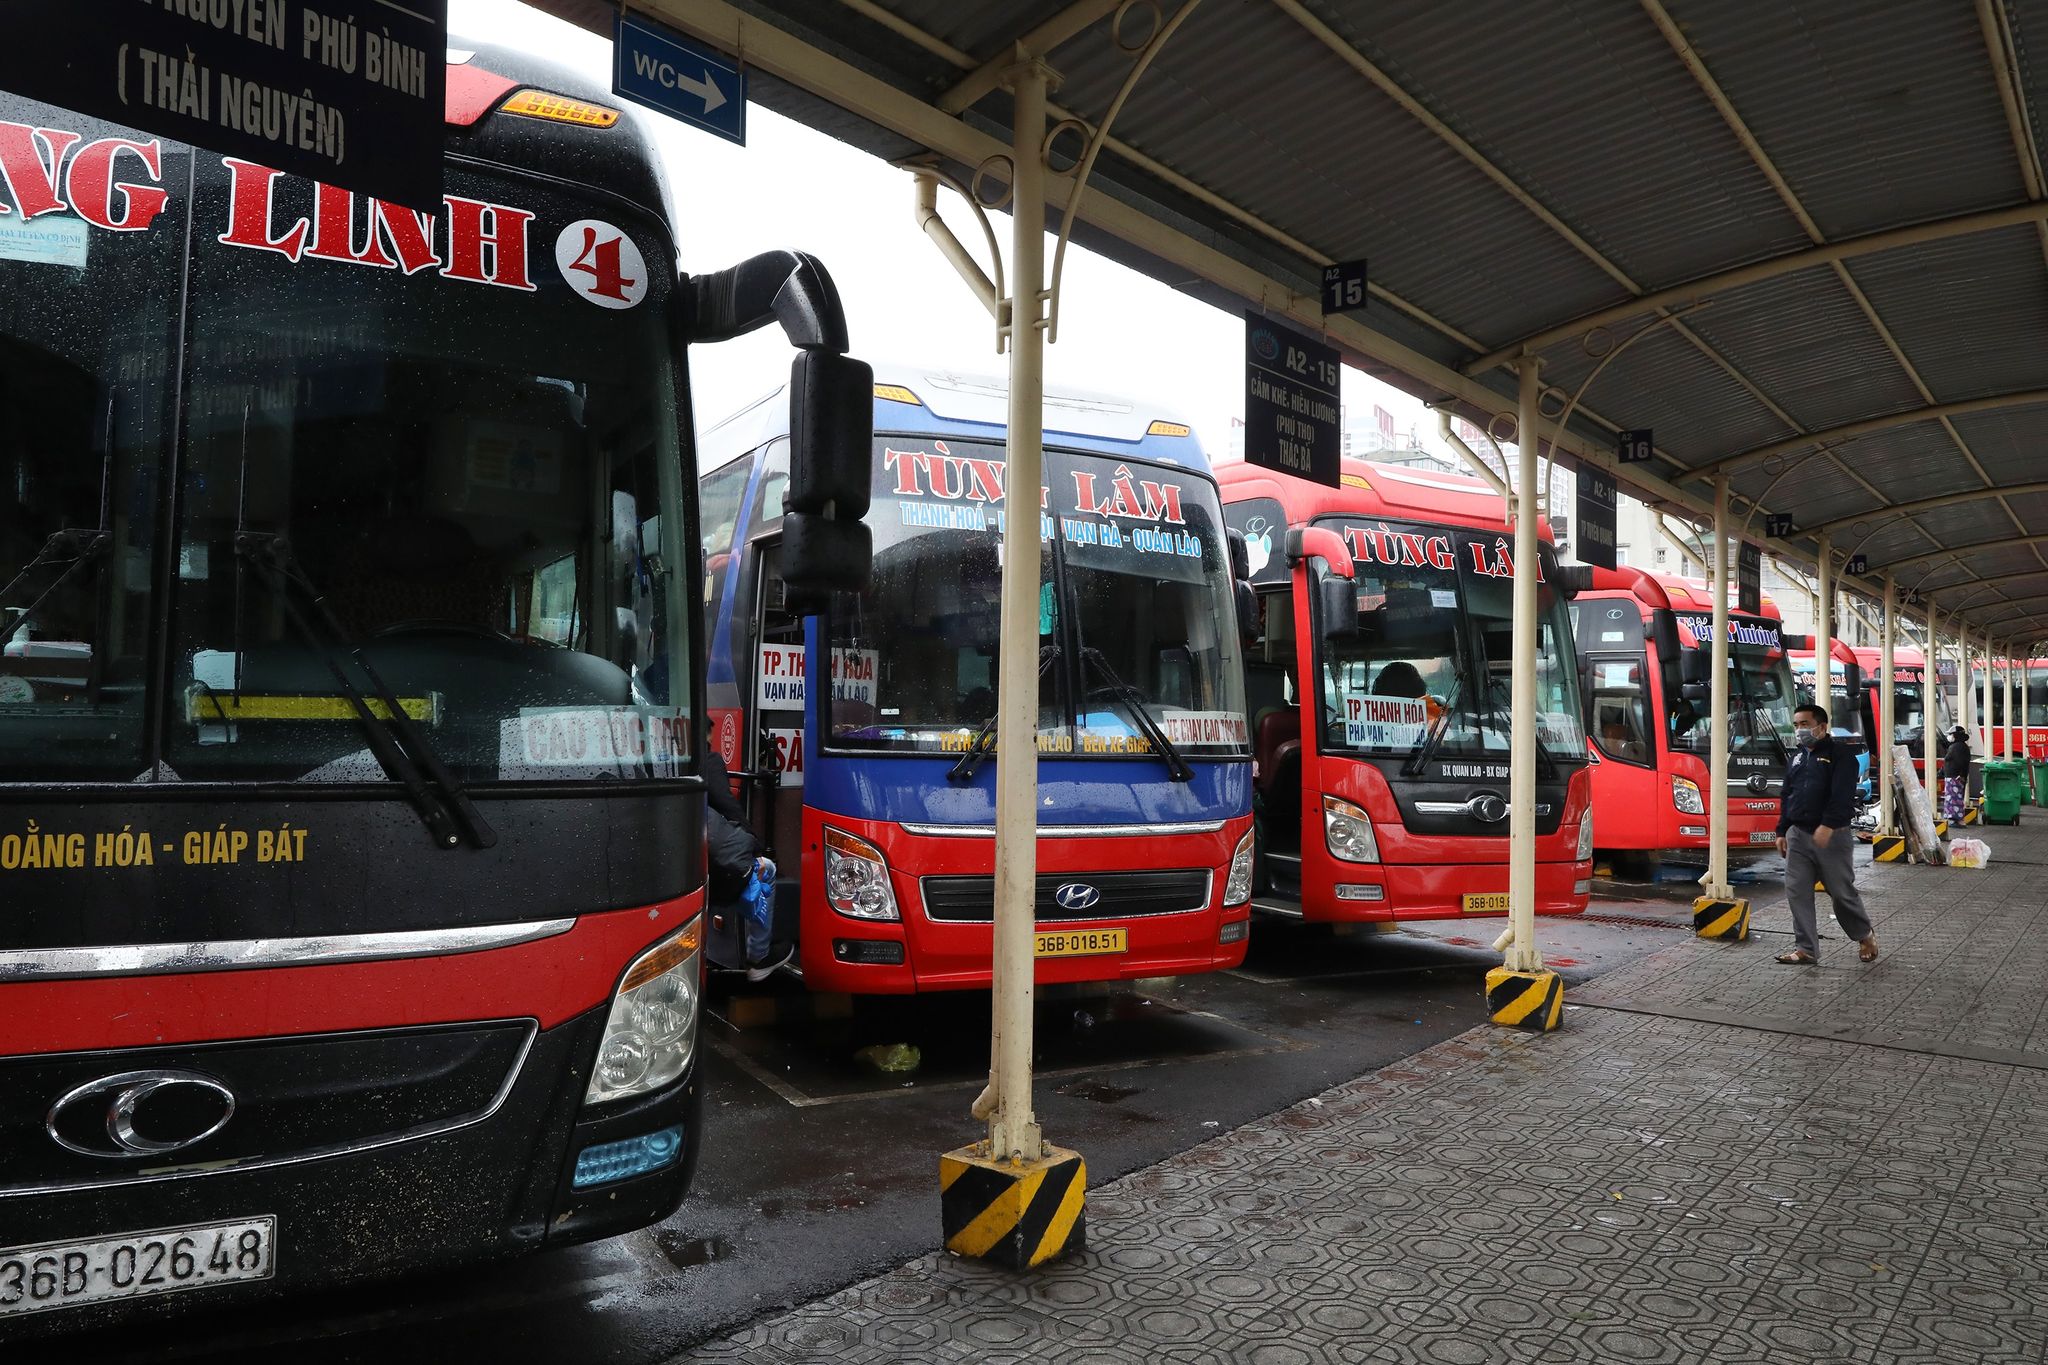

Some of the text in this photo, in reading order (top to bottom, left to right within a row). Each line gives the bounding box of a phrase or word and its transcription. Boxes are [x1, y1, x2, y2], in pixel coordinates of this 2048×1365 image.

[303, 8, 358, 74] PHÚ
[366, 26, 426, 99] BÌNH
[633, 49, 676, 89] WC
[569, 228, 635, 302] 4
[1324, 267, 1340, 281] A2
[1331, 279, 1363, 307] 15
[1625, 441, 1649, 459] 16
[1070, 464, 1186, 525] LÂM
[900, 502, 955, 530] THANH
[954, 502, 987, 532] HOÁ
[1063, 519, 1097, 548] VẠN
[1099, 518, 1122, 548] HÀ
[1133, 525, 1173, 555] QUÁN
[1175, 530, 1203, 558] LÀO
[1771, 522, 1790, 535] 17
[1344, 521, 1455, 571] TÙNG
[764, 682, 787, 703] VẠN
[1347, 699, 1425, 725] TP THANH HÓA
[1110, 736, 1124, 753] XE
[1203, 718, 1221, 743] CAO
[95, 824, 154, 867] HÓA
[183, 823, 248, 866] GIÁP
[256, 823, 308, 863] BÁT
[1037, 933, 1118, 953] 36B-018.51
[0, 1229, 261, 1304] 36B-026.48
